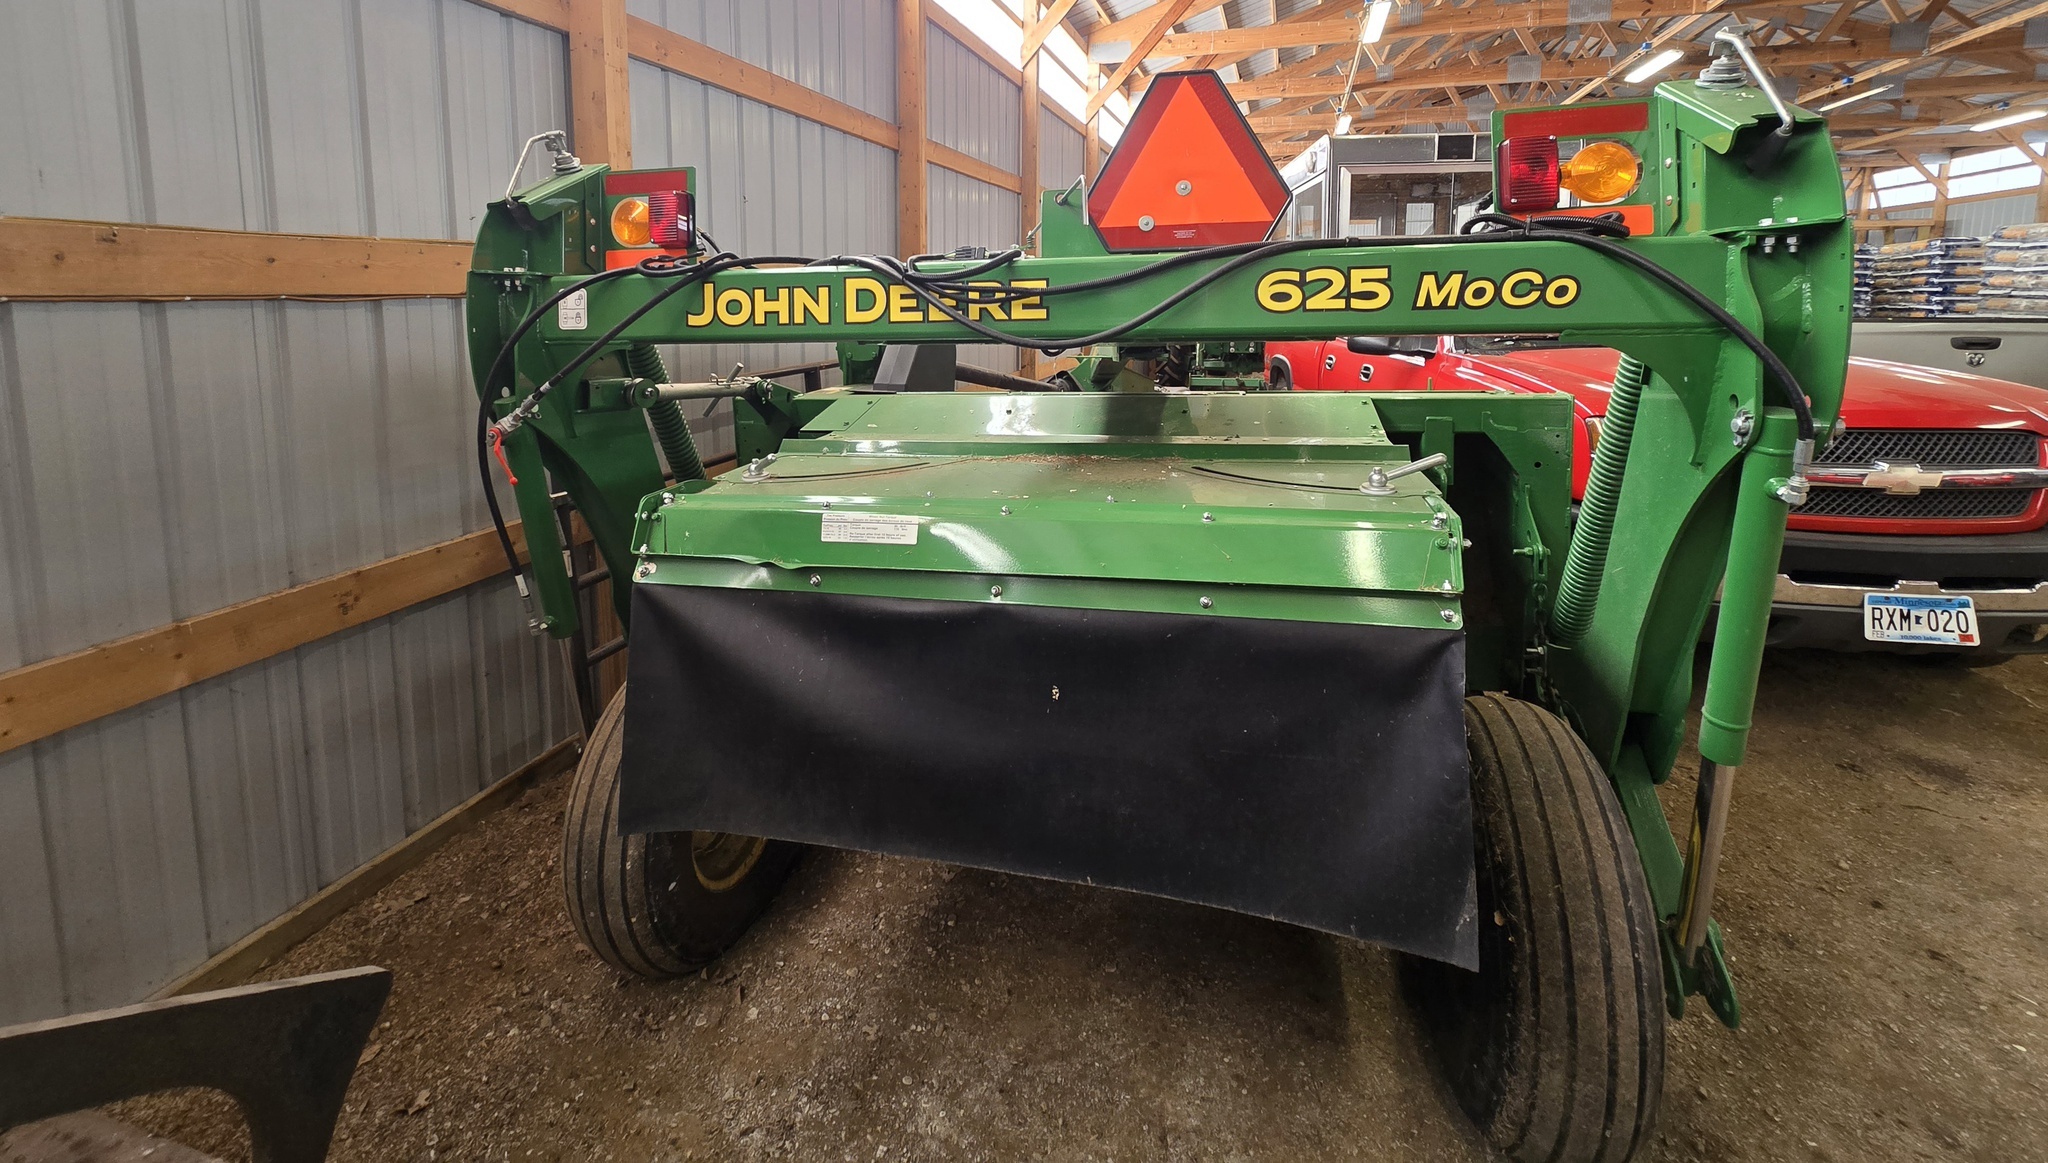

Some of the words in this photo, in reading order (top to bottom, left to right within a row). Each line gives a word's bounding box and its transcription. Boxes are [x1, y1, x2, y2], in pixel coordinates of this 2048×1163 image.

[686, 281, 832, 327] JOHN
[1254, 265, 1394, 313] 625
[1412, 269, 1582, 311] MoCo
[1871, 607, 1912, 632] RXM
[1927, 609, 1970, 634] 020
